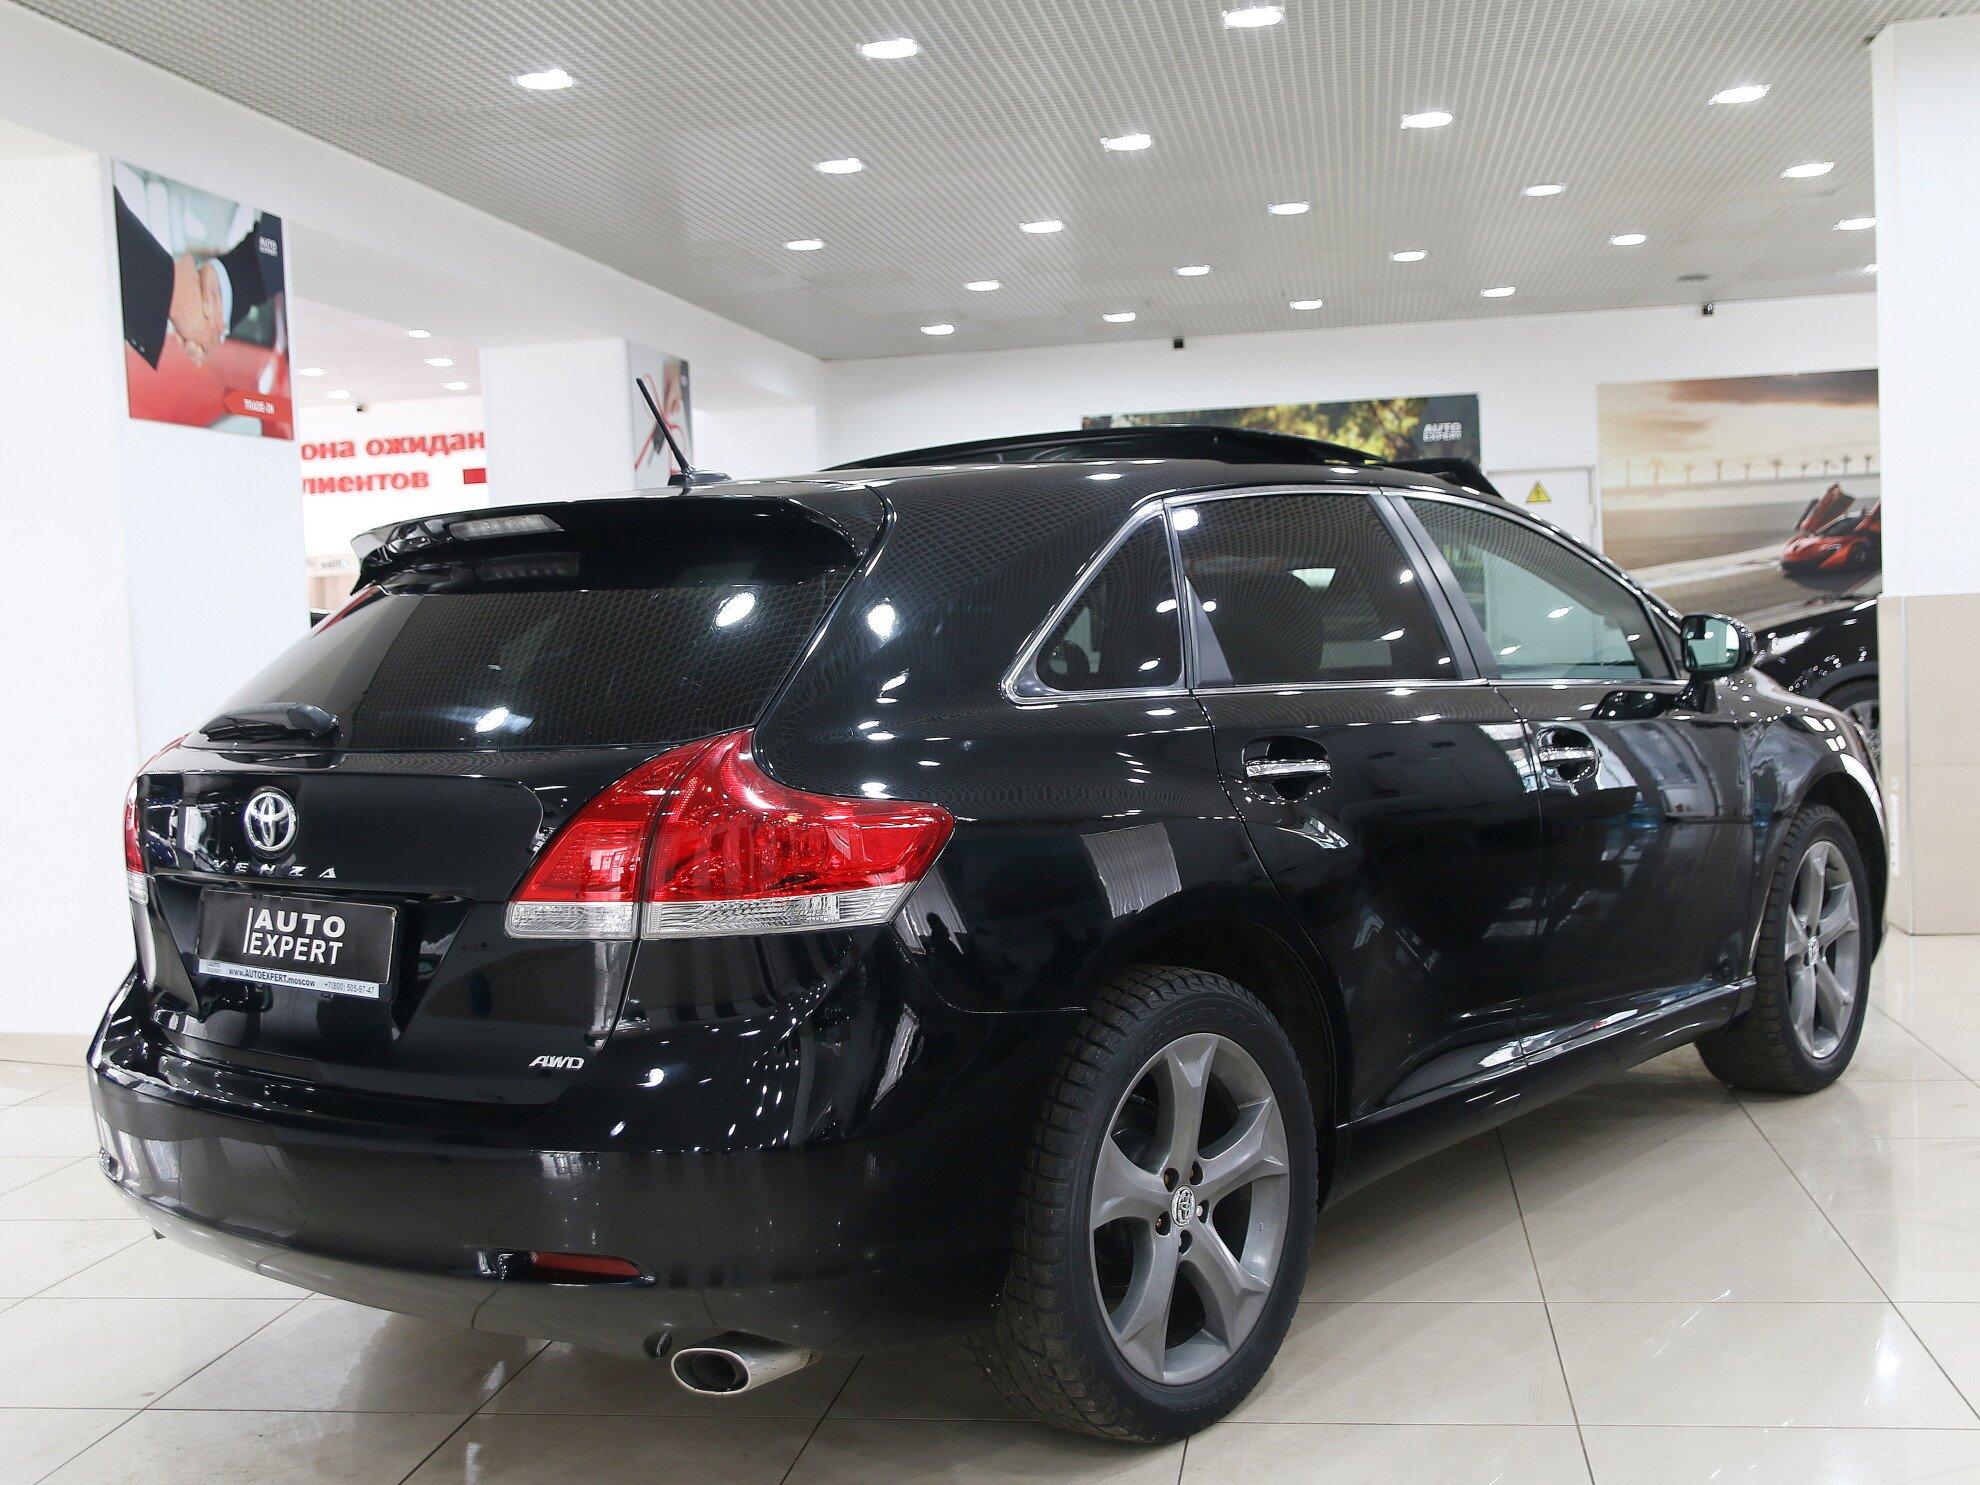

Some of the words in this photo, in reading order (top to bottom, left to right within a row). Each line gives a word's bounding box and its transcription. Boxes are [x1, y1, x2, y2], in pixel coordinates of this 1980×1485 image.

[1424, 421, 1463, 432] AUTO
[366, 432, 485, 457] ожидан
[213, 859, 337, 879] VENZA
[253, 908, 346, 938] AUTO
[250, 935, 344, 965] EXPERT
[228, 968, 316, 987] www.AUTOEXPERT.moscow
[528, 1055, 585, 1069] AWD
